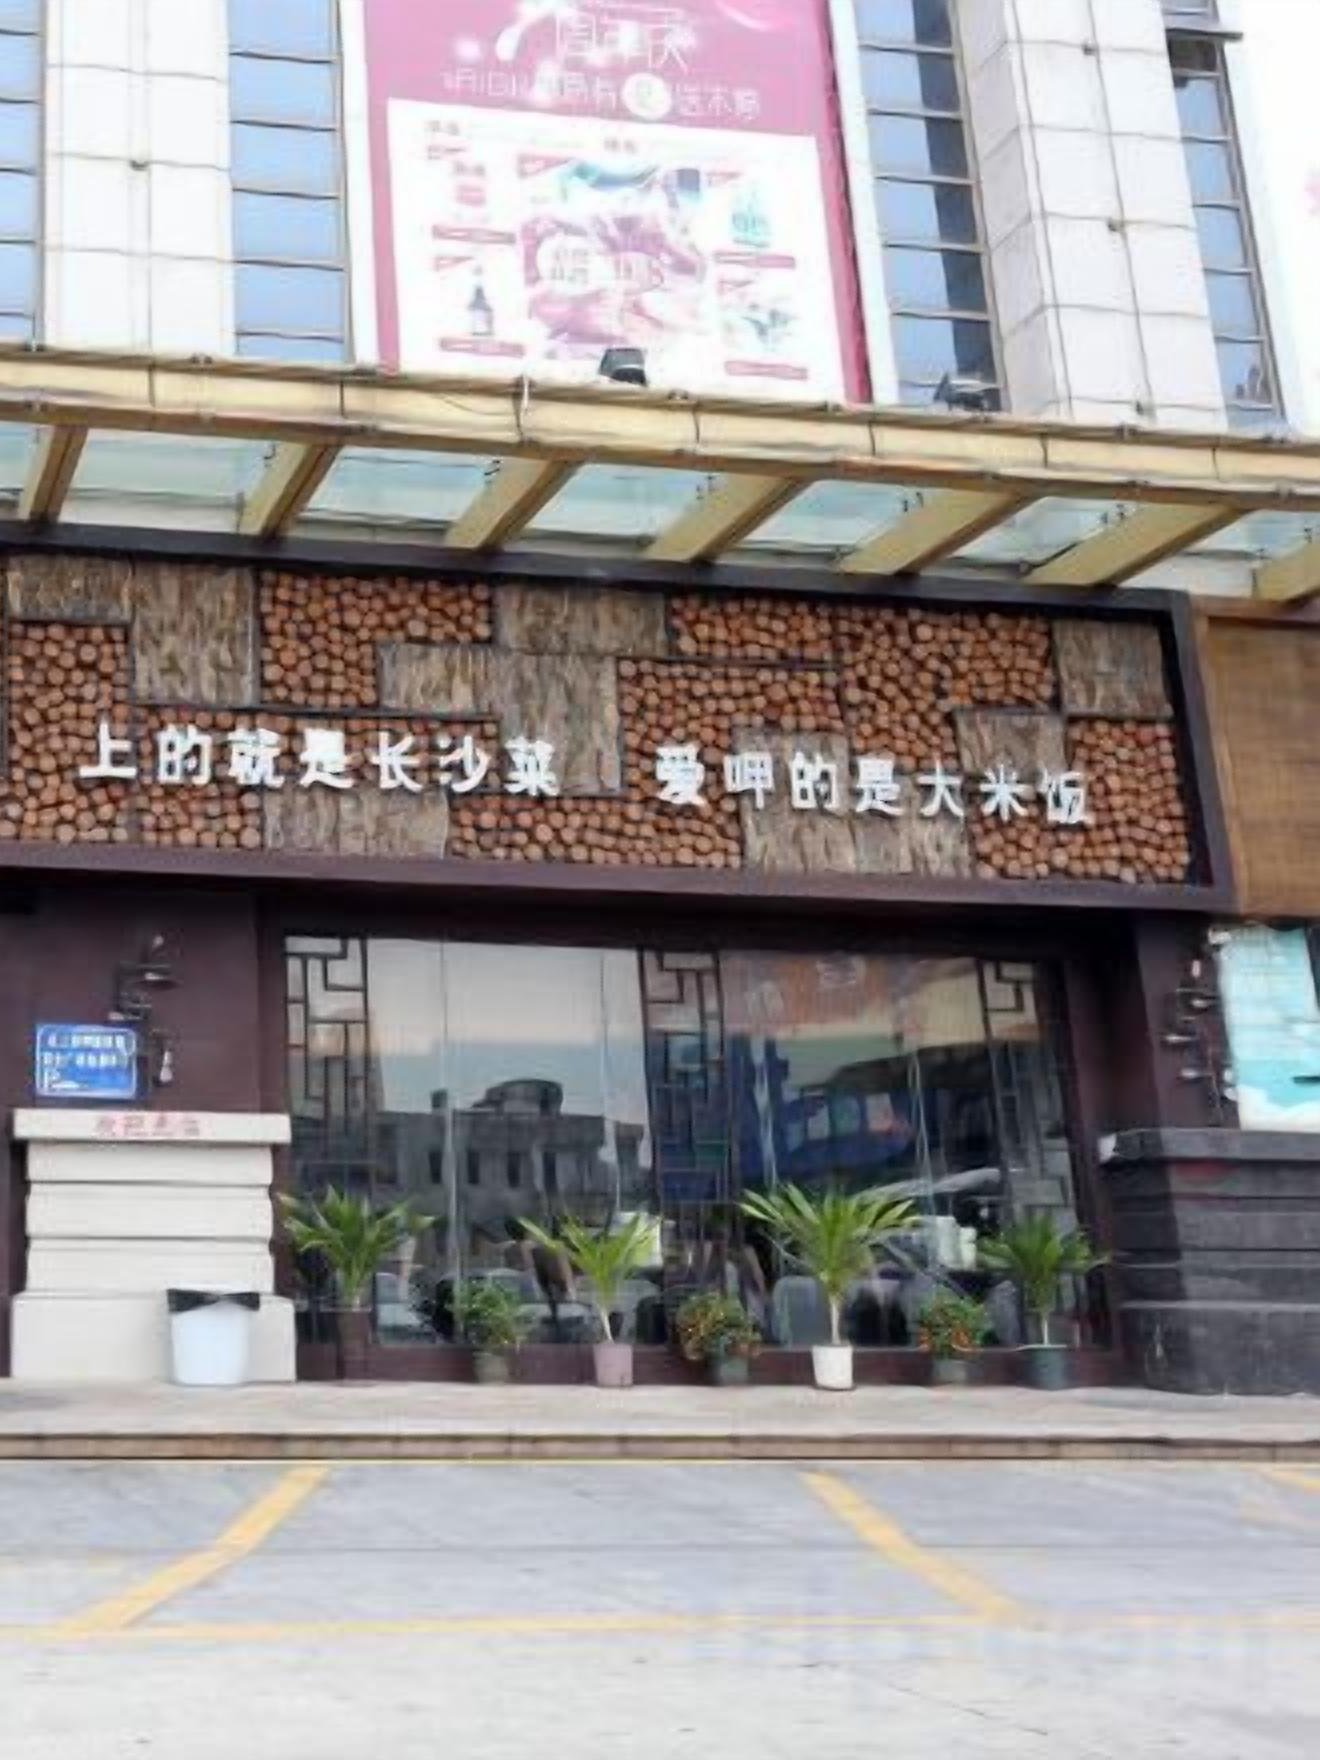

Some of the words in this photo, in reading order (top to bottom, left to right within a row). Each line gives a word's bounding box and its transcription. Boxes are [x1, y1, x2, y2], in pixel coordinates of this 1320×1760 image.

[79, 716, 561, 797] 上的就是长沙菜
[655, 743, 1096, 825] 爱呷的是大米饭
